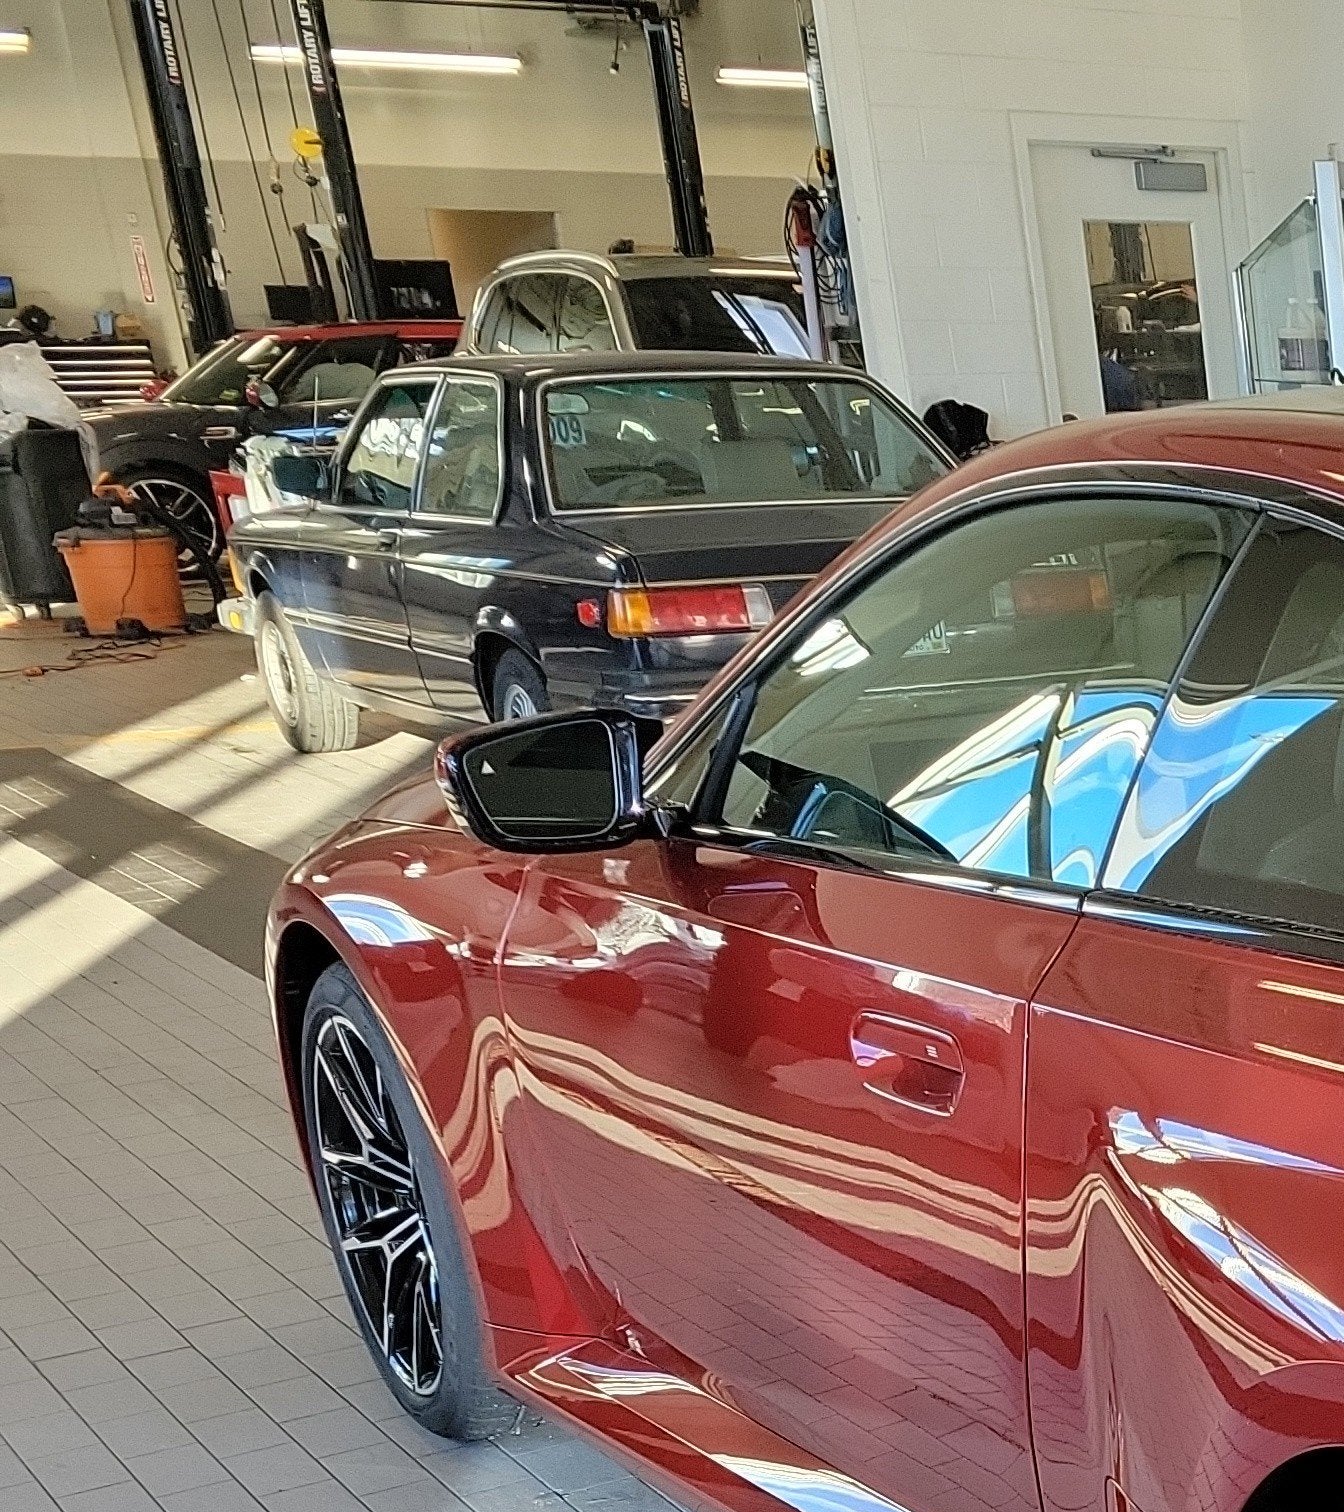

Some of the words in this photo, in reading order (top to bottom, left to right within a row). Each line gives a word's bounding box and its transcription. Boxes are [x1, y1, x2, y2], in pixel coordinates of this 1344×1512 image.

[302, 29, 323, 84] ROTARY
[670, 19, 680, 47] LIFT
[675, 49, 689, 101] ROTARY
